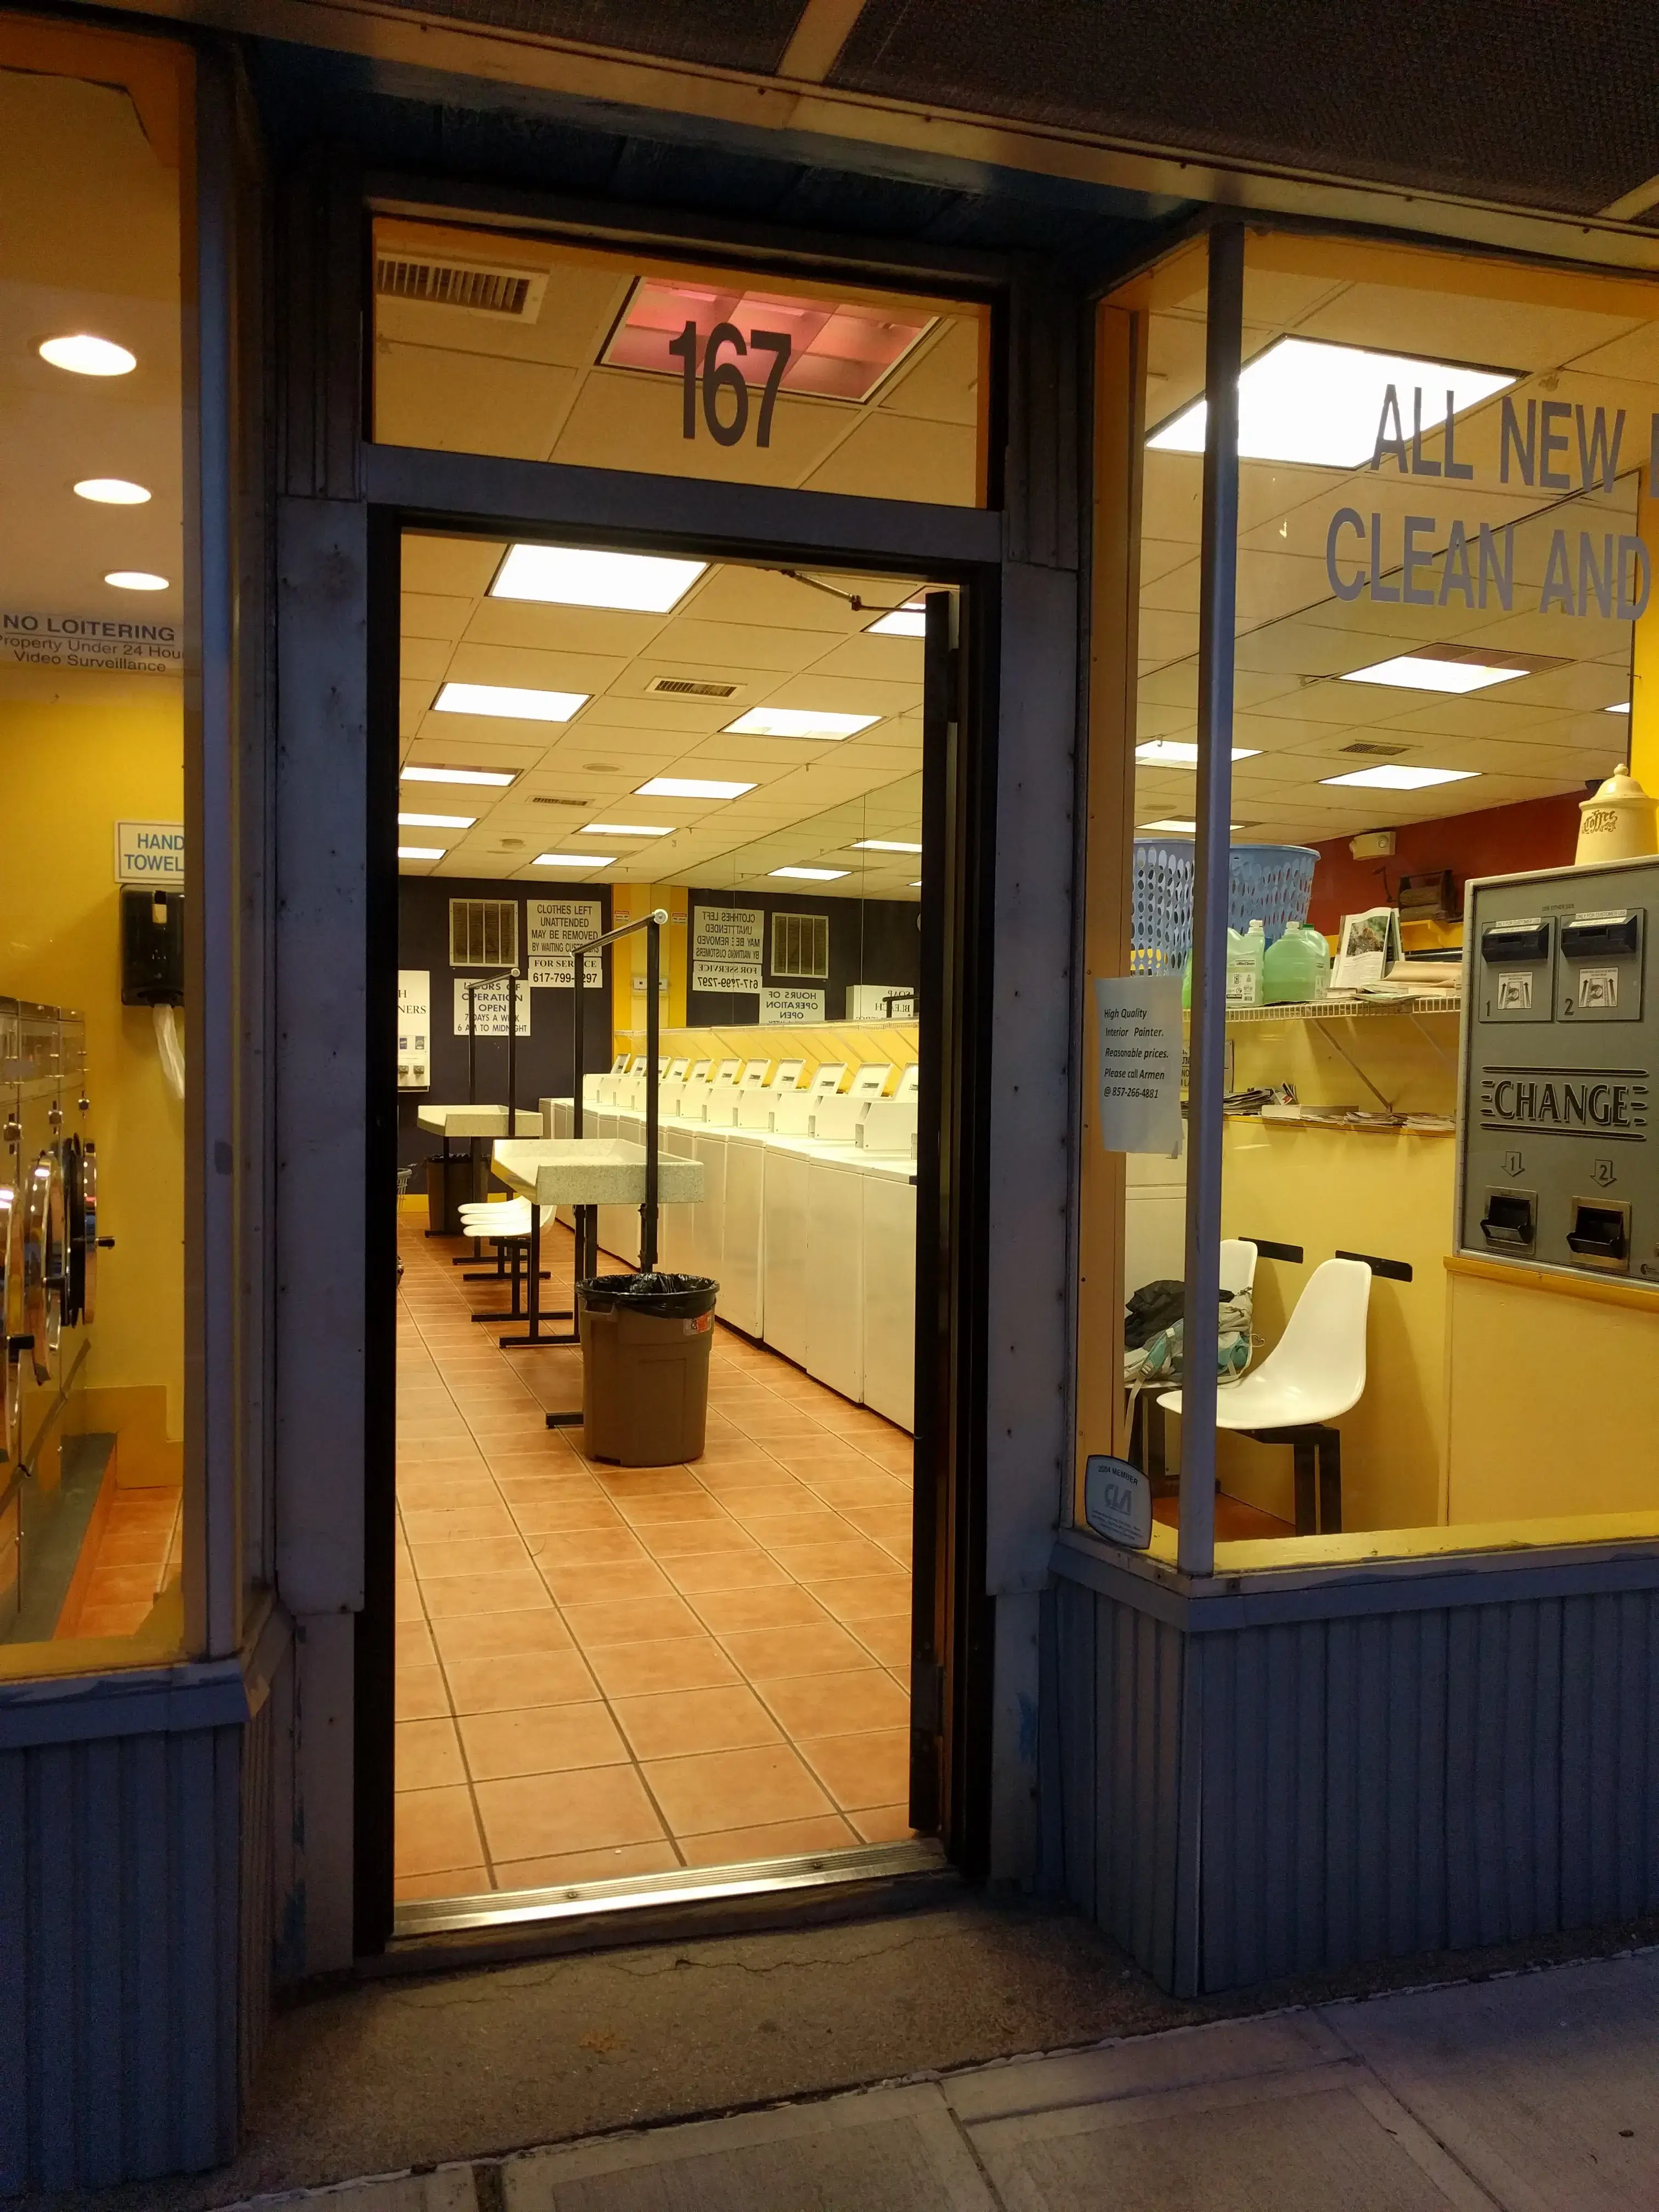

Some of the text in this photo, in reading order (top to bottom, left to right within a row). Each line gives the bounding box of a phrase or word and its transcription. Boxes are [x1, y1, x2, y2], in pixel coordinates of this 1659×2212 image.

[669, 320, 792, 447] 167
[1372, 384, 1474, 480] ALL
[1500, 397, 1626, 494] NEW
[1327, 507, 1651, 621] CLEAN AND
[3, 614, 174, 641] NO LOITERING
[68, 640, 117, 654] Under
[123, 645, 143, 656] 24
[14, 650, 166, 672] Video Surveillance
[137, 833, 184, 850] HAND
[537, 904, 592, 915] CLOTHES LEFT
[540, 917, 589, 927] UNATTENDED
[532, 929, 598, 940] MAY BE REMOVED
[532, 943, 539, 951] BY
[541, 943, 563, 952] WAITING
[533, 973, 597, 983] 617-799-297
[1104, 1008, 1147, 1020] High Quality
[1486, 998, 1575, 1017] 1 2
[1105, 1027, 1164, 1036] Interior Painter.
[1105, 1048, 1142, 1058] Reasonable
[1144, 1048, 1169, 1060] prices.
[1104, 1068, 1165, 1079] Please call Armen
[1104, 1086, 1158, 1098] @ 857-266-4881
[1494, 1080, 1629, 1125] CHANGE
[1510, 1156, 1609, 1180] 1 2
[1112, 1468, 1138, 1486] MEMBER
